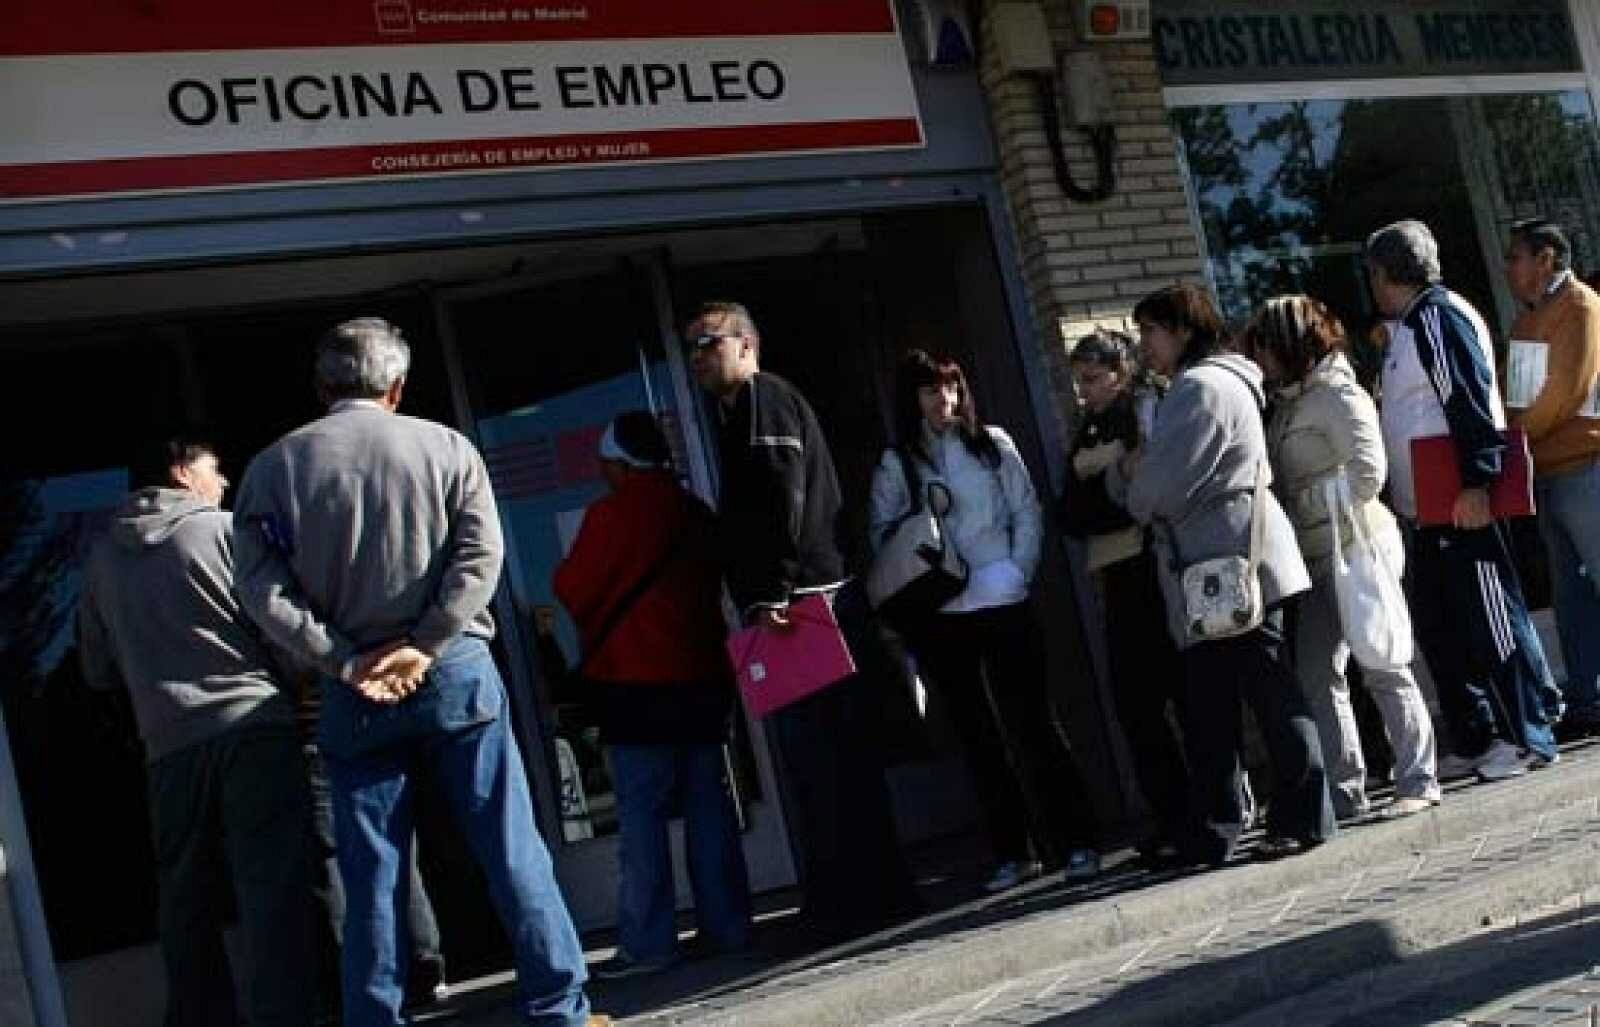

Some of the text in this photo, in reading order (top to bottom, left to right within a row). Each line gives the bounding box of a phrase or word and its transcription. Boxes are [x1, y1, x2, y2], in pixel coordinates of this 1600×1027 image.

[168, 60, 786, 126] OFICINA DE EMPLEO
[484, 149, 507, 164] DE
[511, 145, 576, 162] EMPLEO
